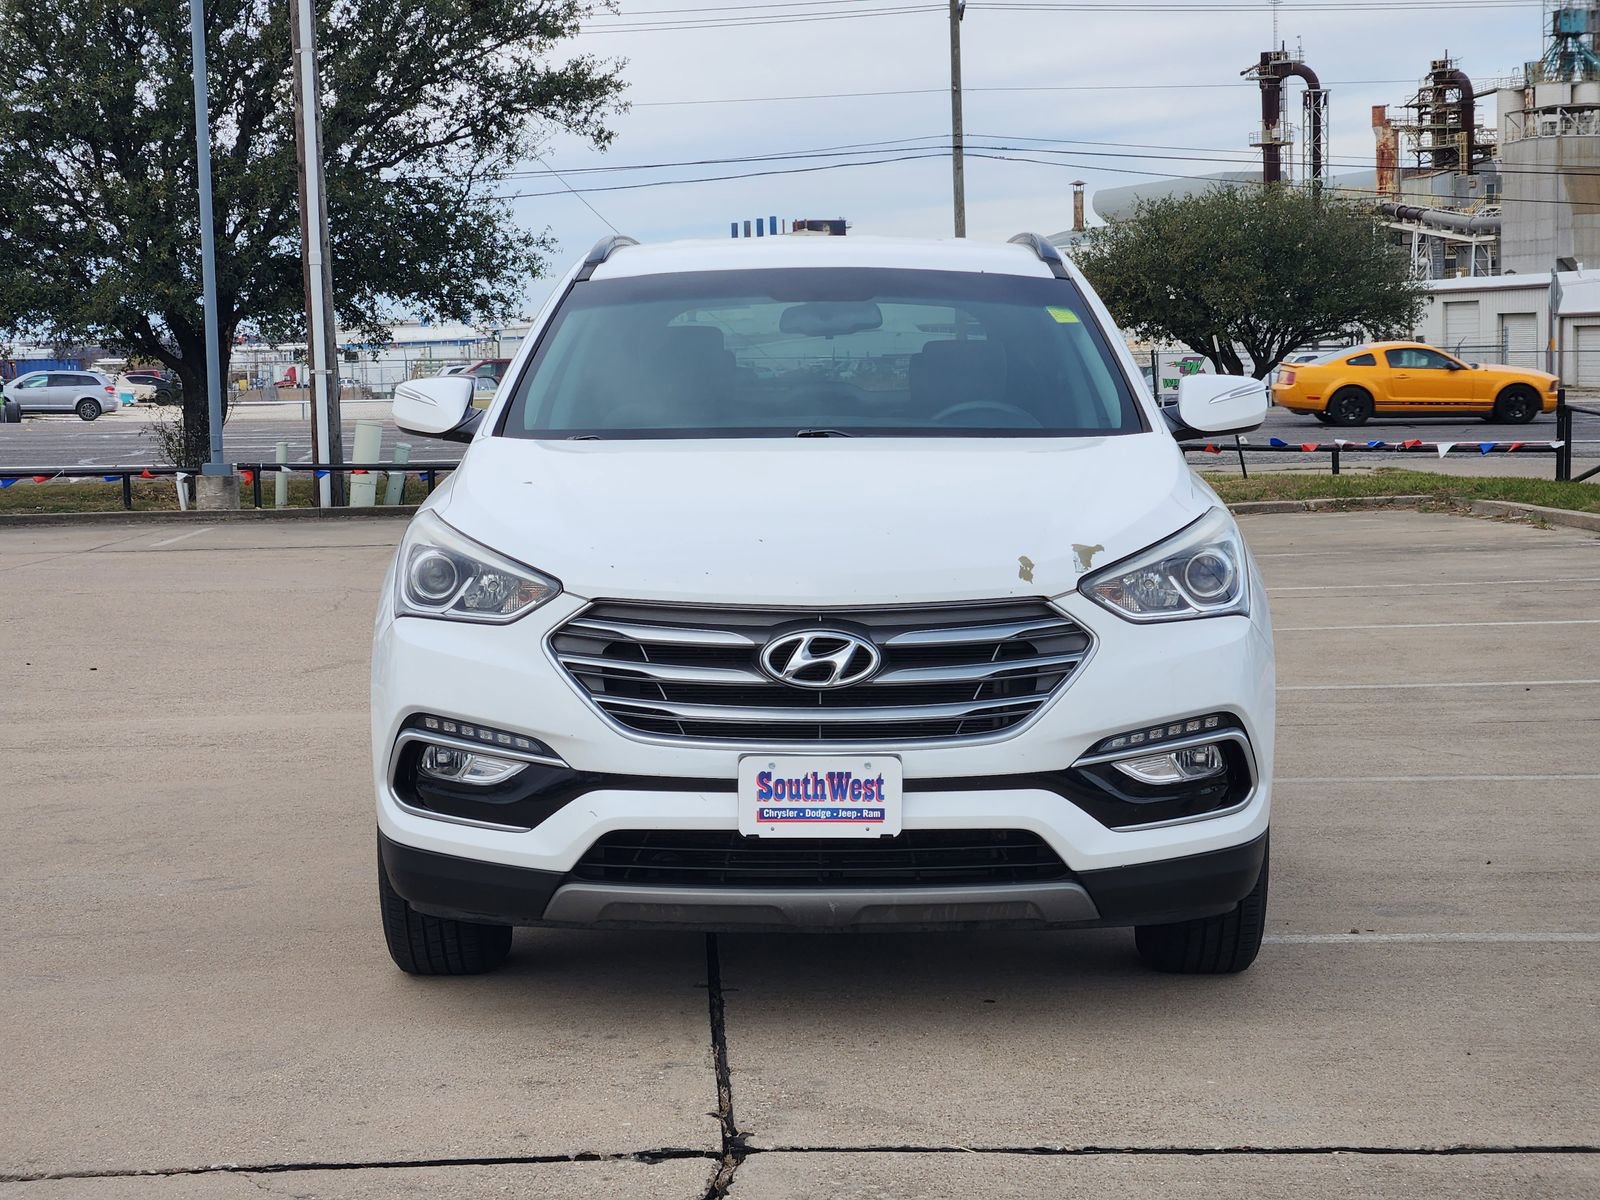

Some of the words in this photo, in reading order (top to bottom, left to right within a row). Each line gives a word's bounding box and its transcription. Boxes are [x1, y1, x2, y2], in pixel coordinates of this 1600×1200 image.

[756, 771, 885, 802] SouthWest
[763, 808, 798, 820] Chrysler
[805, 808, 831, 819] Dodge
[837, 808, 857, 819] Jeep
[862, 808, 881, 818] Ram
